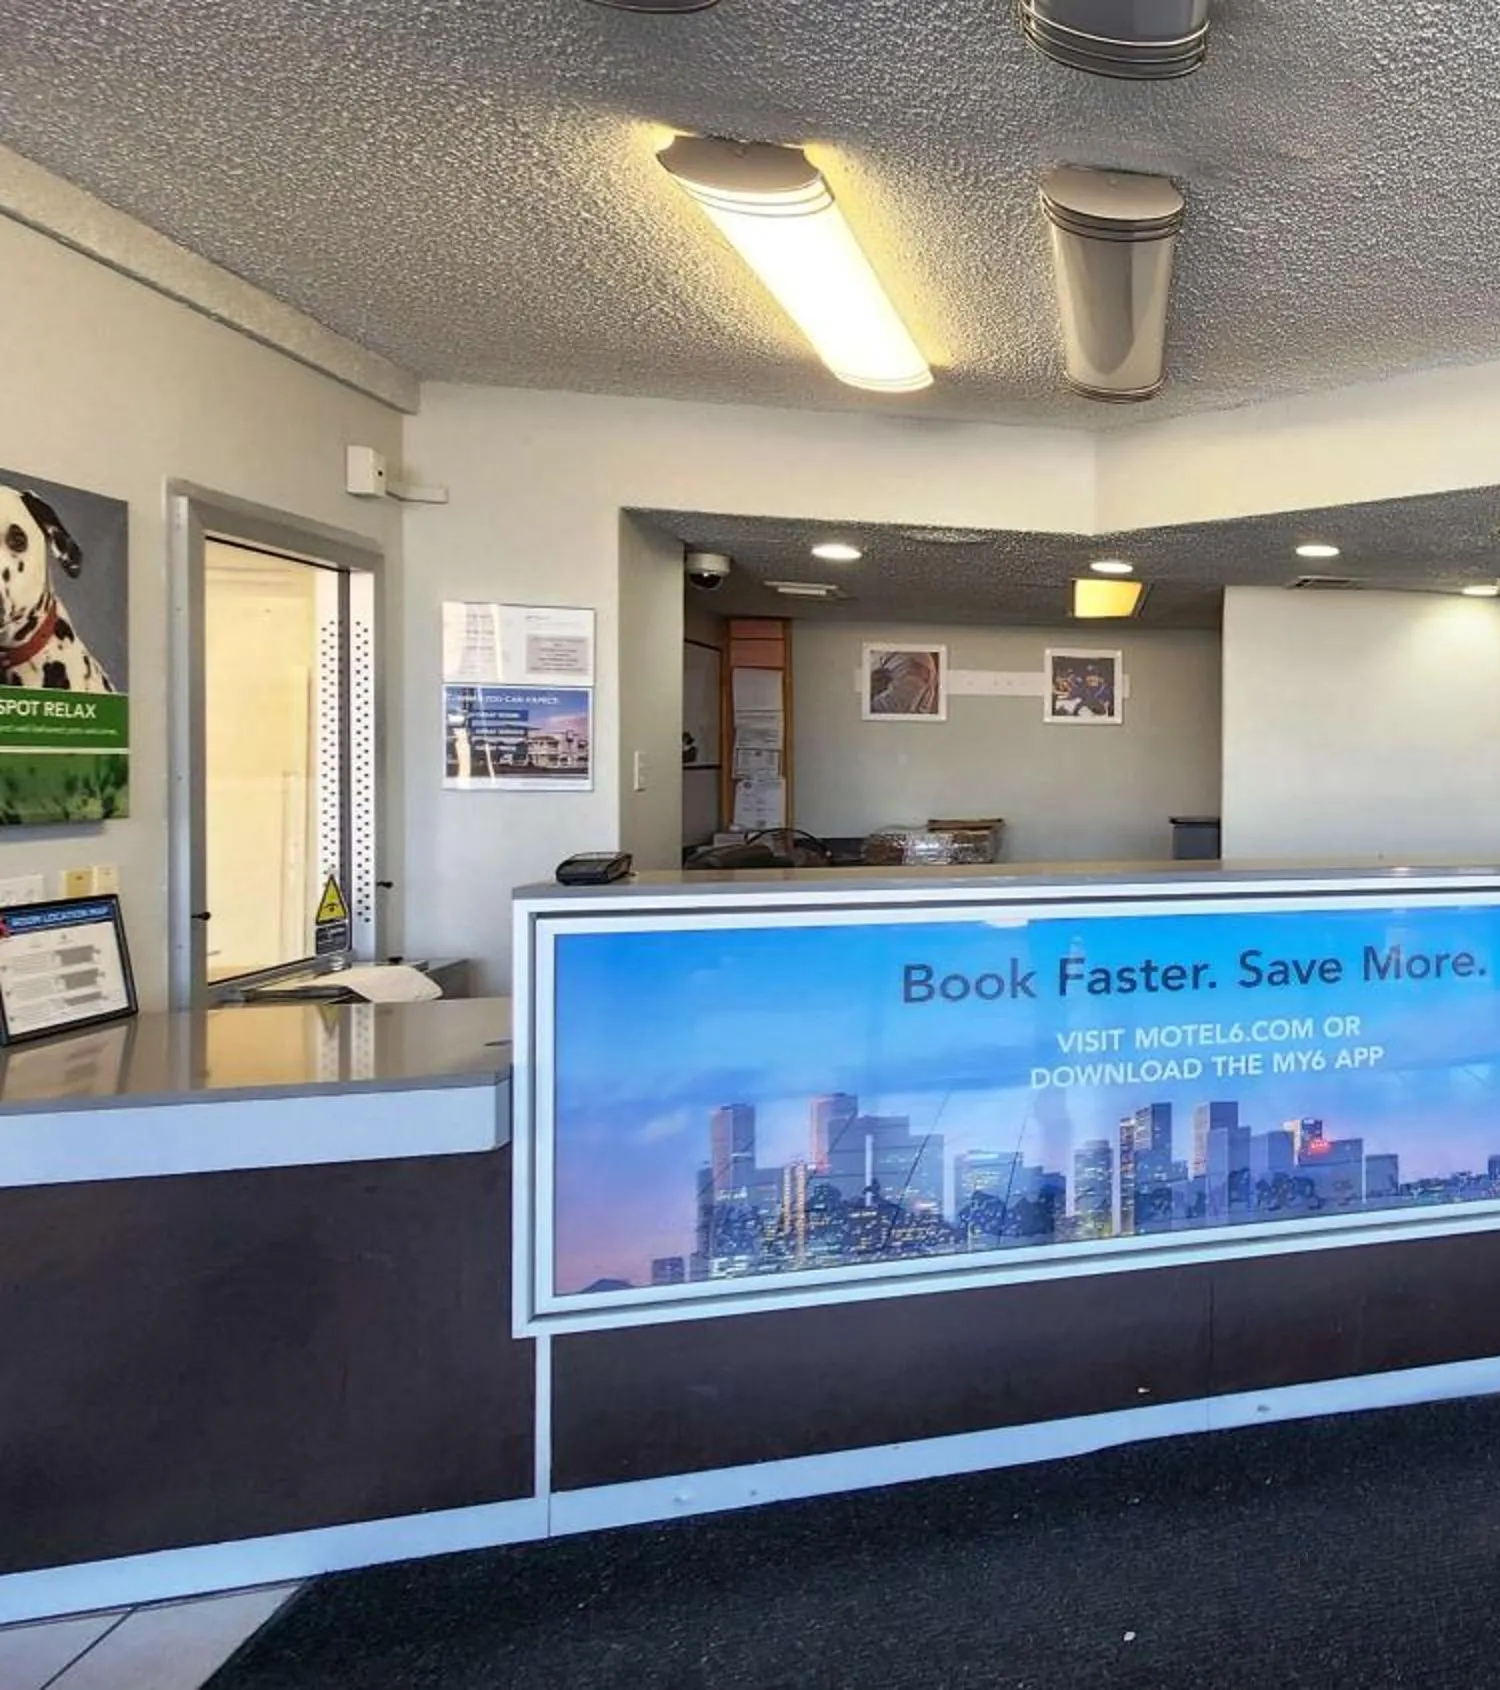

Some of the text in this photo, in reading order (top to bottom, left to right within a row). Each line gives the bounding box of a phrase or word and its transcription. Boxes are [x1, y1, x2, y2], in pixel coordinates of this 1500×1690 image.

[0, 699, 97, 719] SPOT RELAX
[903, 945, 1486, 1003] Book Faster. Save More.
[1056, 1015, 1361, 1053] VISIT MOTEL6.COM OR
[1030, 1045, 1384, 1089] DOWNLOAD THE MY6 APP
